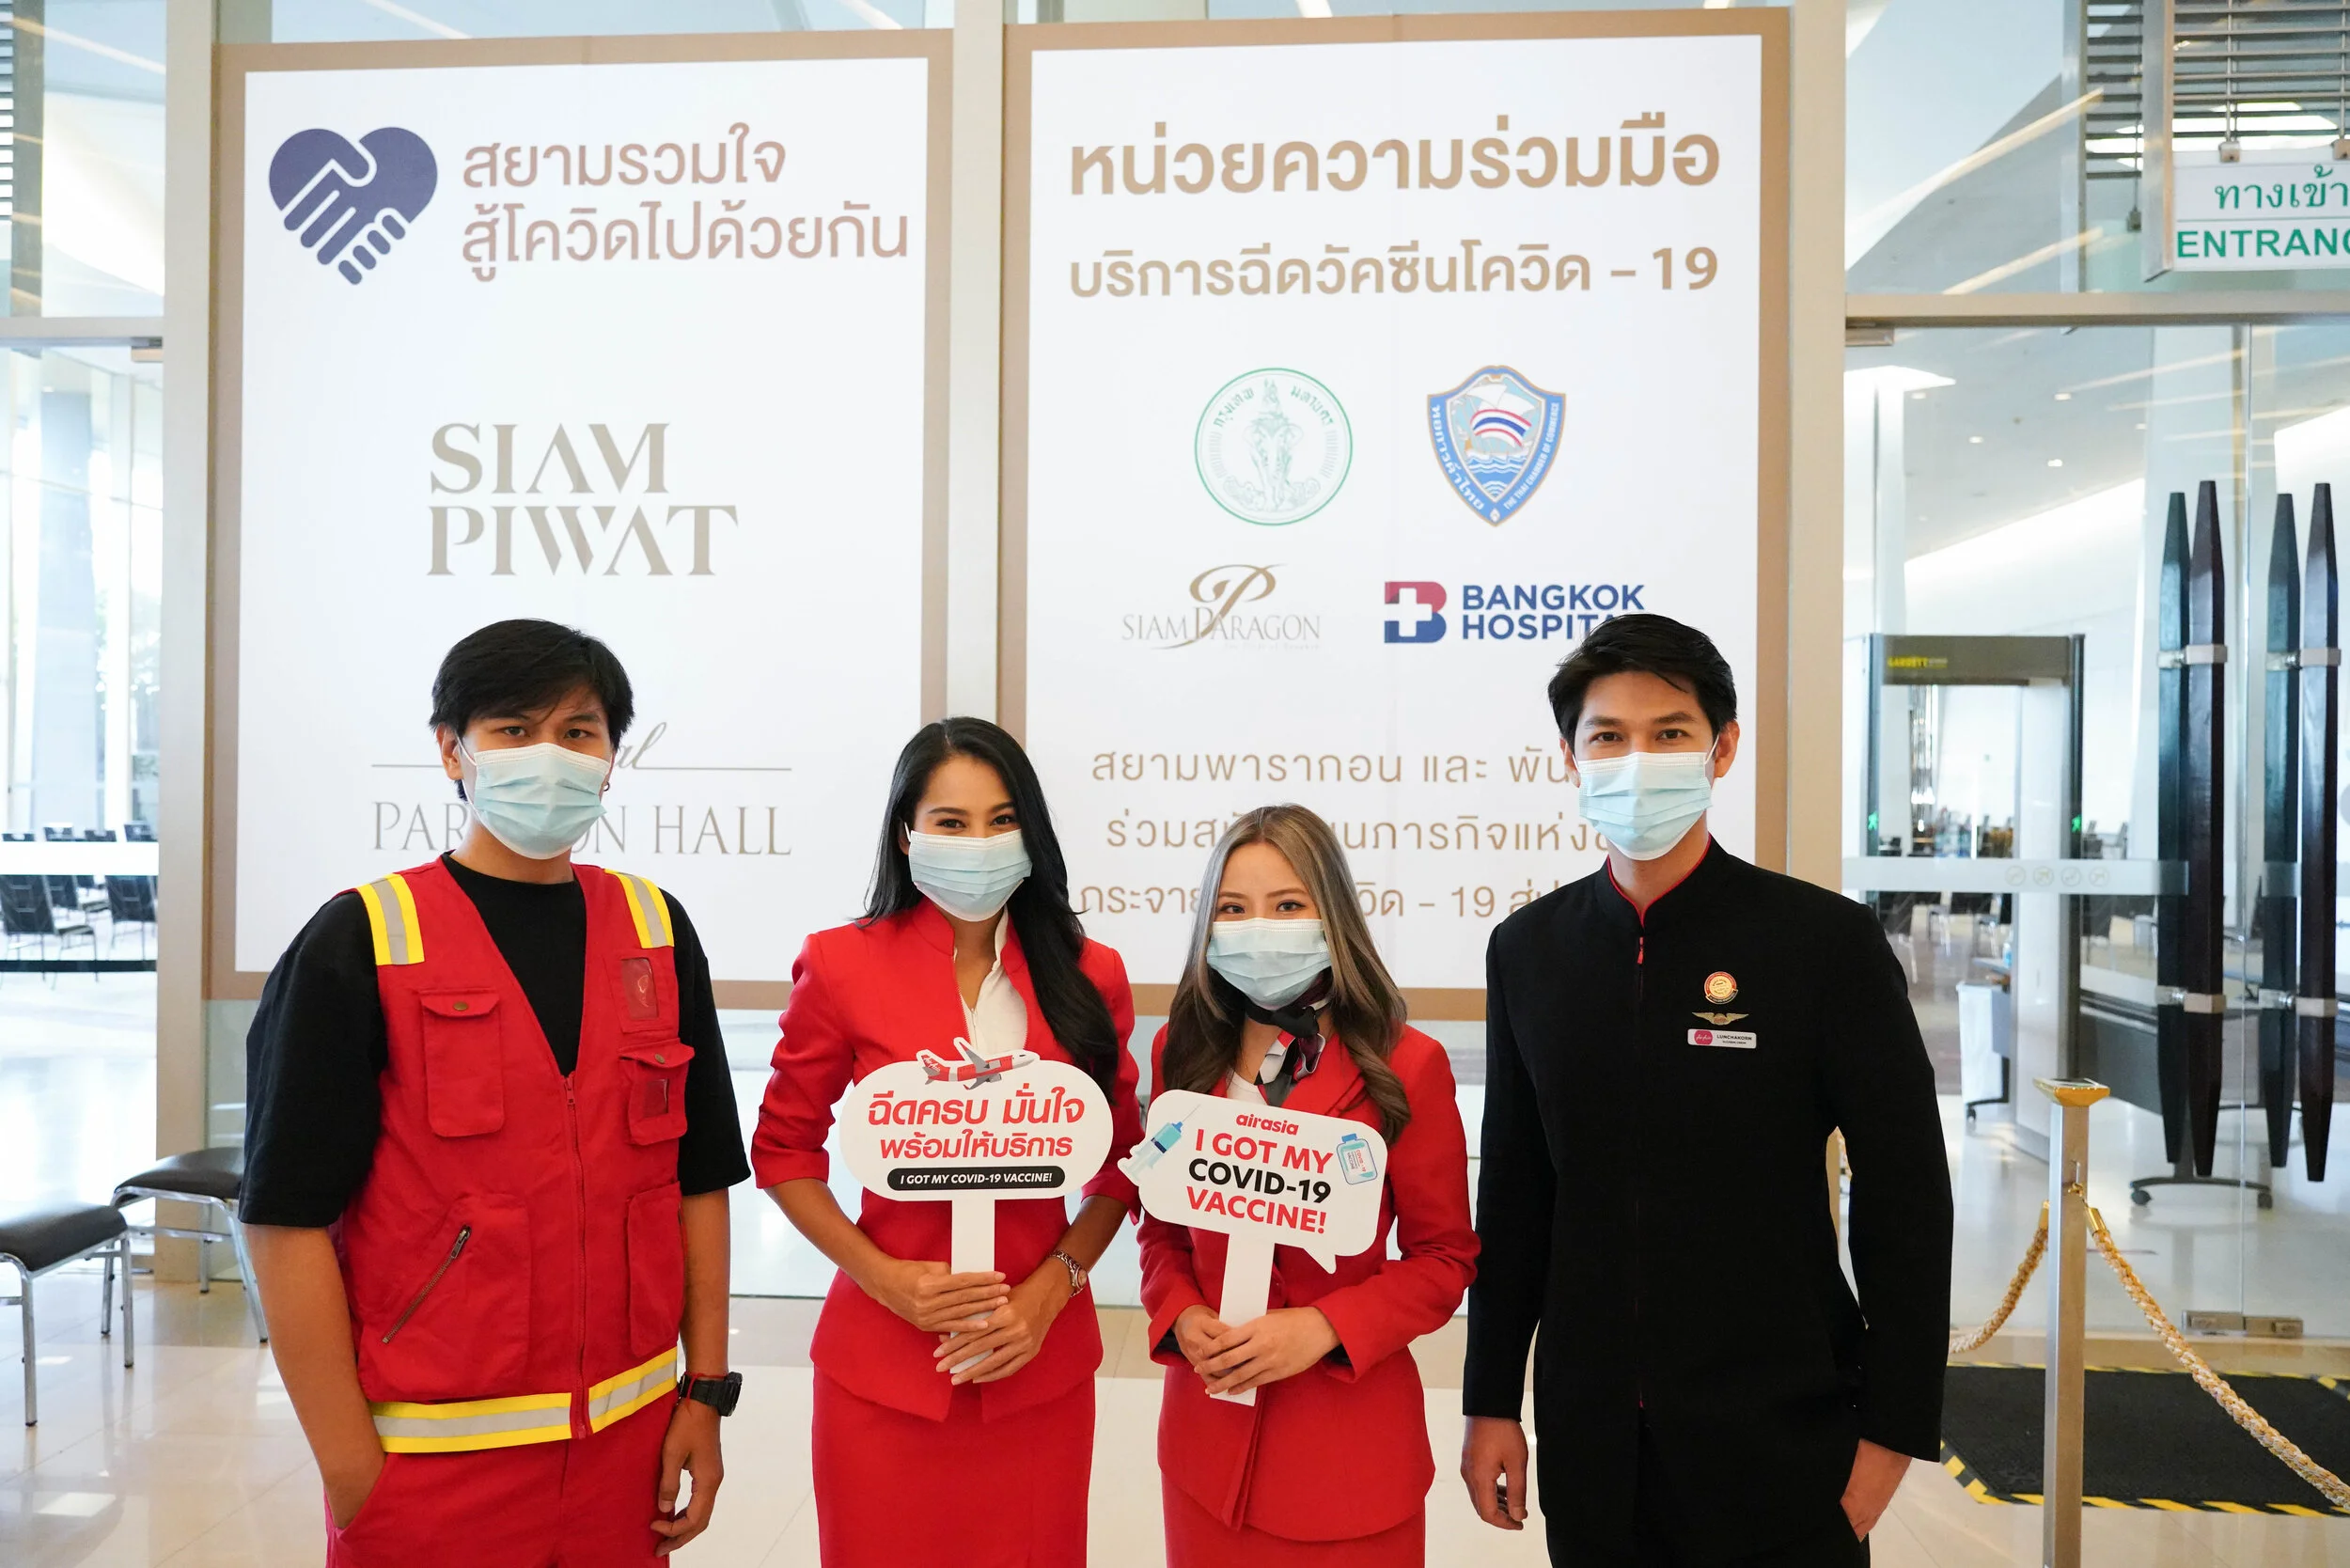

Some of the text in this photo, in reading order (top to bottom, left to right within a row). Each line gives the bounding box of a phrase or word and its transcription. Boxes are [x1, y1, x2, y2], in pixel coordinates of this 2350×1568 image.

[462, 121, 787, 189] สยามรวมใจ
[1070, 110, 1720, 196] หน่วยความร่วมมือ
[2215, 164, 2349, 210] ทางเข้า
[462, 198, 909, 283] สู้โควิดไปด้วยกัน
[2177, 227, 2350, 259] ENTRAN
[1069, 239, 1590, 298] บริการฉีดวัคซีนโควิด
[1652, 245, 1718, 290] 19
[430, 421, 670, 495] SIAM
[426, 504, 740, 577] PIWAT
[1463, 584, 1645, 611] BANGKOK
[1121, 606, 1321, 641] SIAM PARAGON
[1463, 613, 1615, 640] HOSPIT
[1090, 745, 1570, 784] สยามพารากอน และ พัน
[372, 800, 792, 855] PARN HALL
[1451, 886, 1496, 917] 19
[868, 1083, 1085, 1125] ฉีดครบ มั่นใจ
[1235, 1113, 1299, 1136] airasia
[880, 1128, 1073, 1159] พร้อมให้บริการ
[1195, 1129, 1204, 1152] I
[1212, 1133, 1277, 1164] GOT
[1281, 1146, 1334, 1174] MY
[900, 1172, 1052, 1184] I GOT MY COVID-19 VACCINE!
[1188, 1157, 1331, 1203] COVID-19
[1186, 1185, 1326, 1234] VACCINE!
